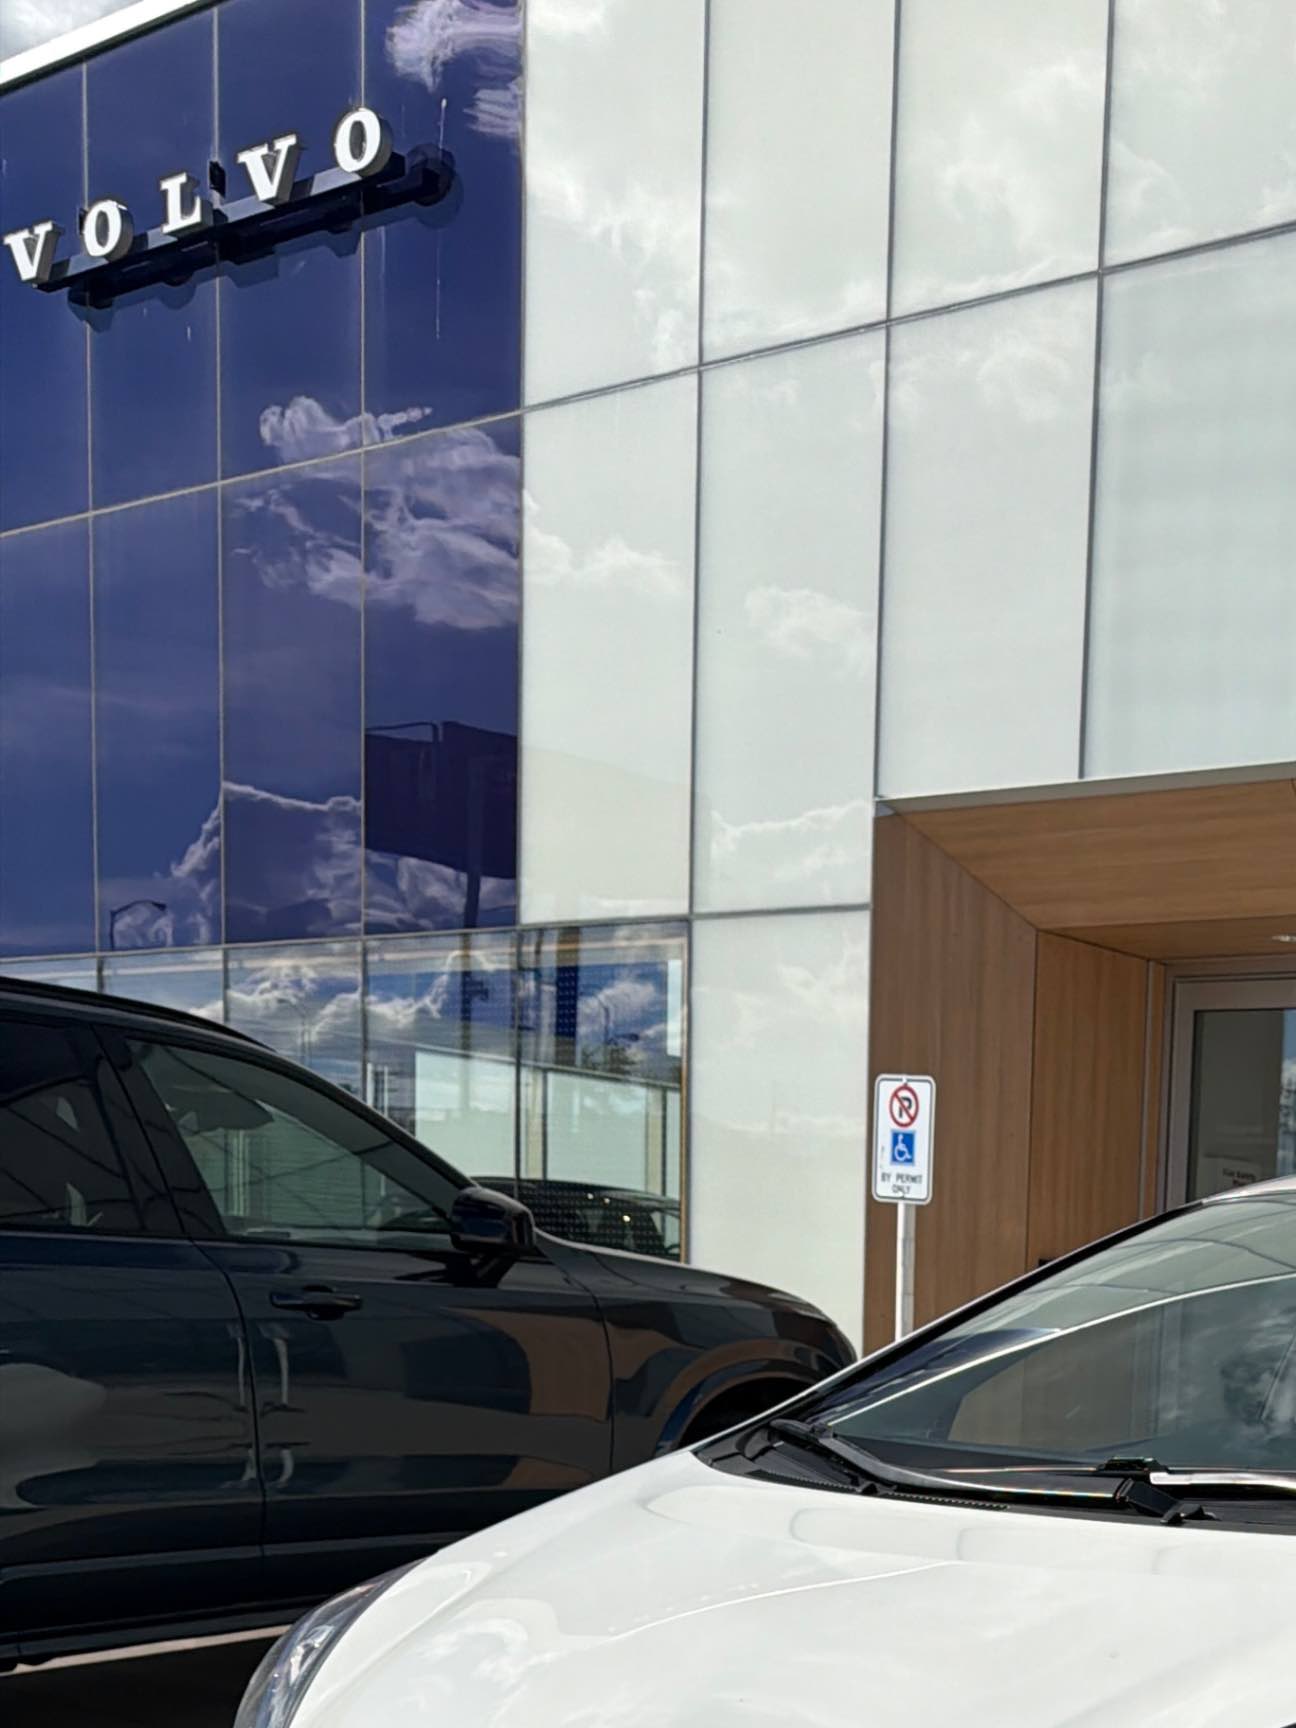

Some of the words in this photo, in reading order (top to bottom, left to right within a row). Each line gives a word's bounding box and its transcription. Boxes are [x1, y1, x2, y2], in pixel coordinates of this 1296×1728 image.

[4, 108, 390, 285] VOLVO
[881, 1172, 891, 1182] BY
[896, 1173, 923, 1184] PERMIT
[891, 1184, 911, 1195] ONLY
